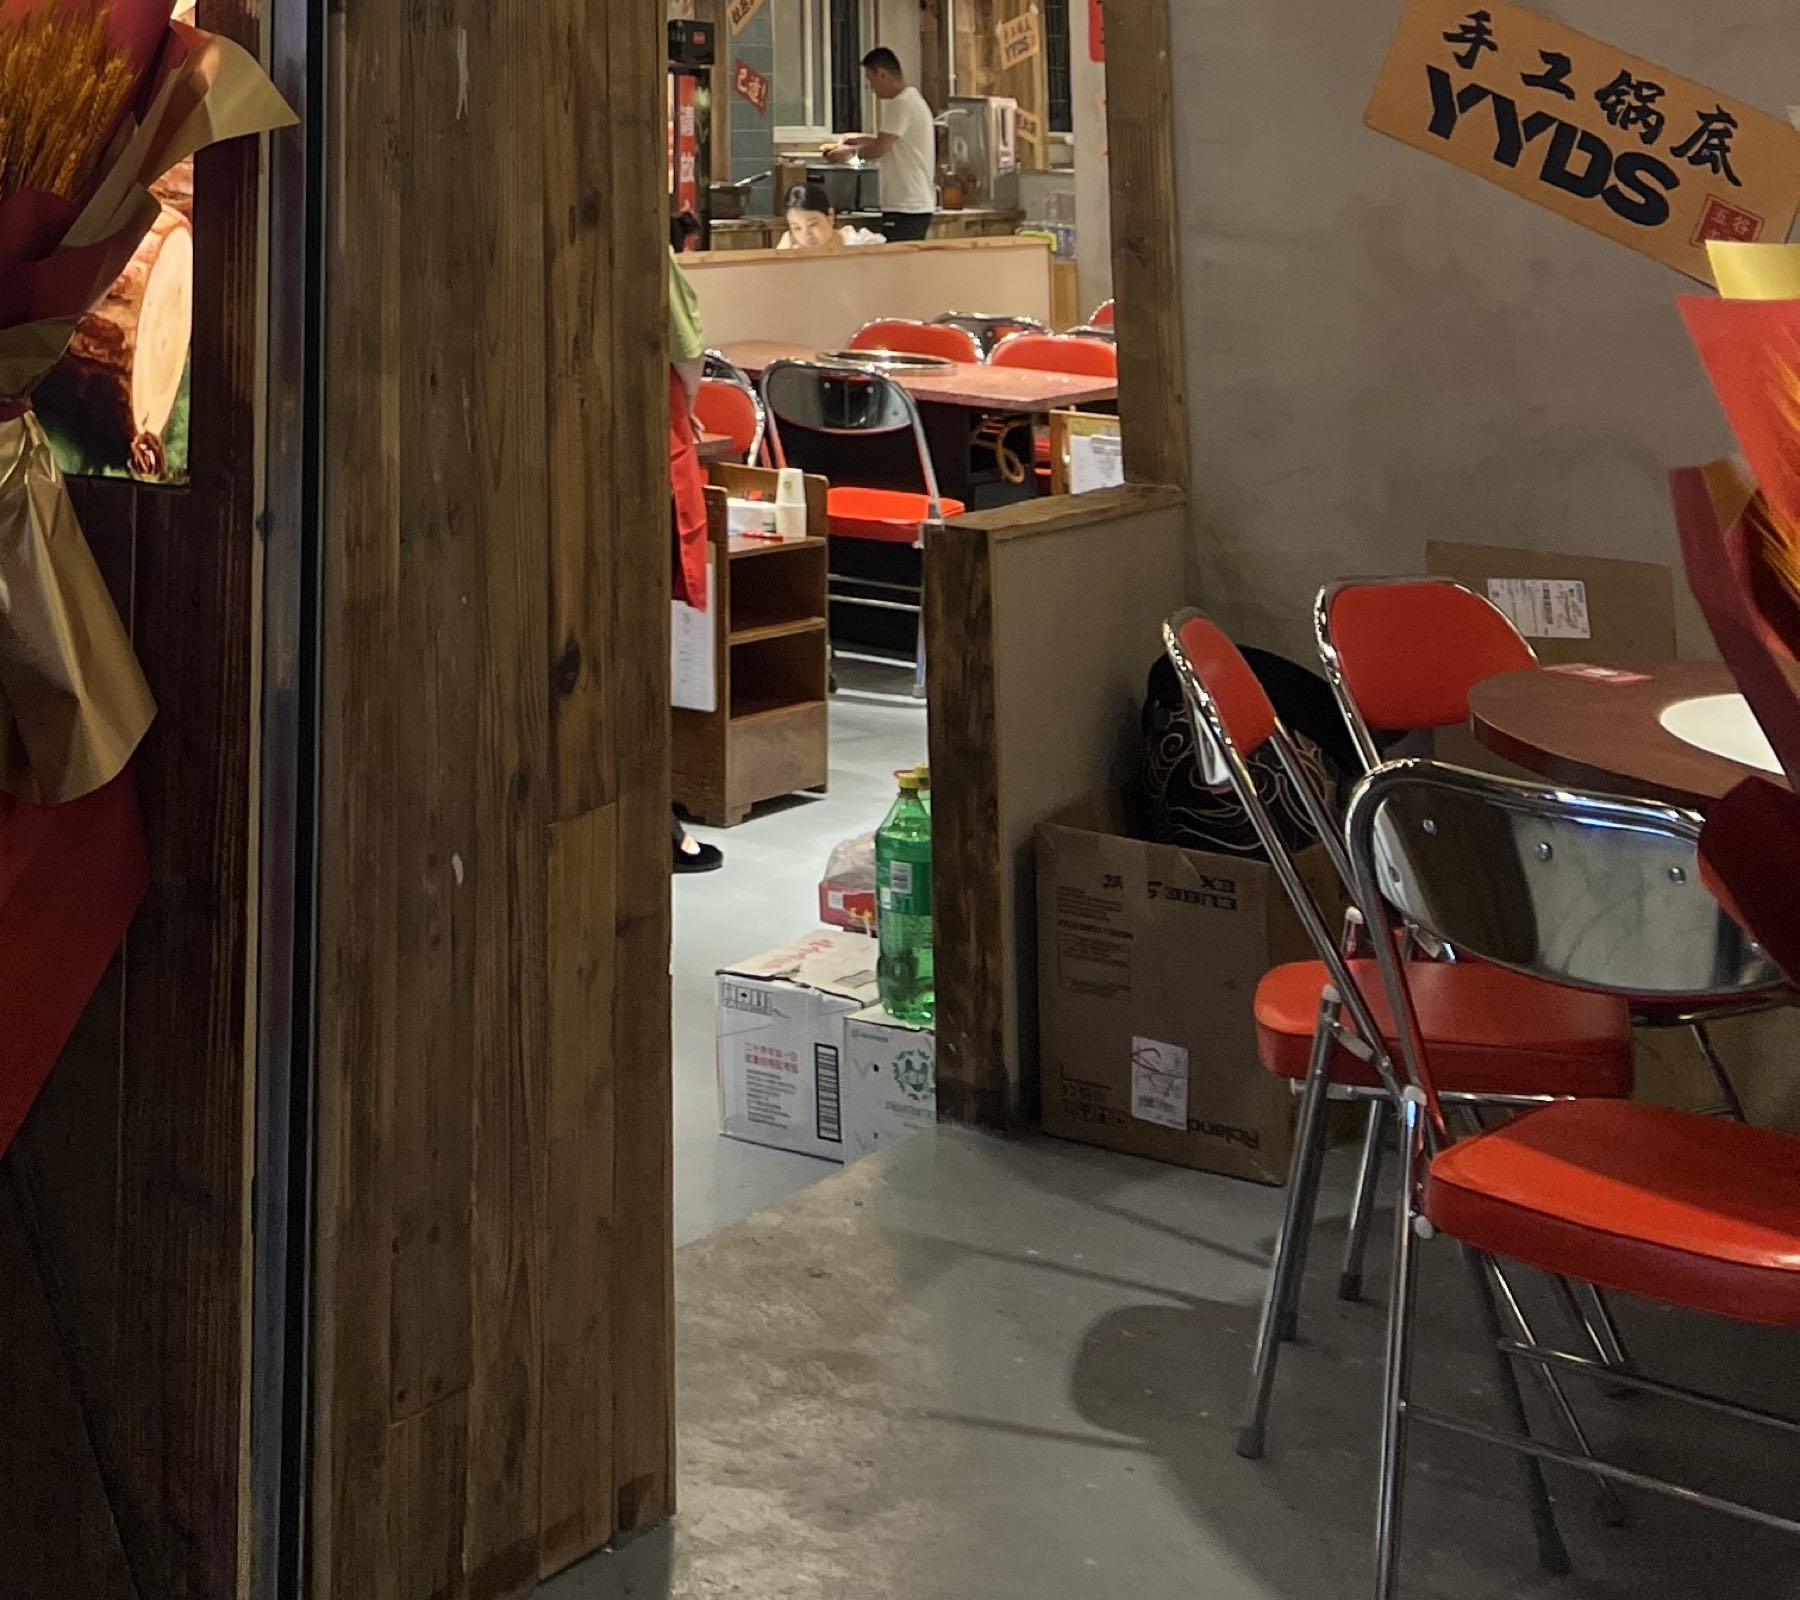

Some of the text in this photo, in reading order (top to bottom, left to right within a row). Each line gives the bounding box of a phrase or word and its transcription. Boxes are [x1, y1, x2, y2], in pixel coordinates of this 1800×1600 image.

[1426, 64, 1680, 228] YYDS
[1441, 10, 1742, 187] 手工锅底
[1186, 1115, 1259, 1150] Roland
